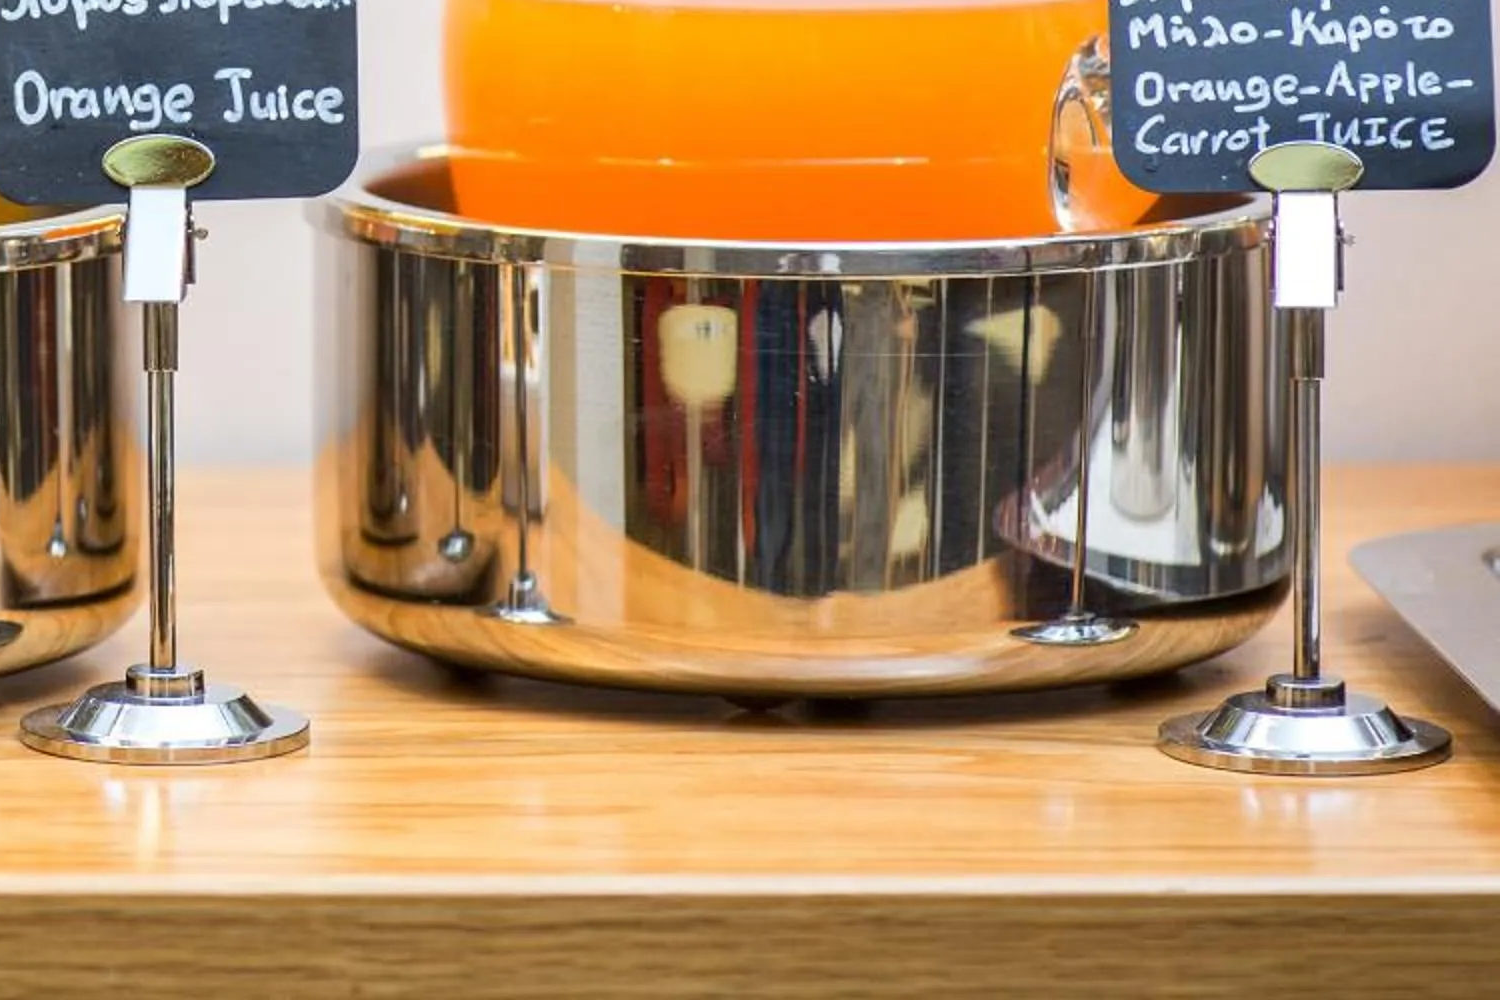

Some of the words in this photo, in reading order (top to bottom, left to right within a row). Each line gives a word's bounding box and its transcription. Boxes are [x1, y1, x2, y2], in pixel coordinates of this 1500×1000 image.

[14, 69, 195, 131] Orange
[214, 68, 345, 124] Juice
[1135, 114, 1271, 155] Carrot
